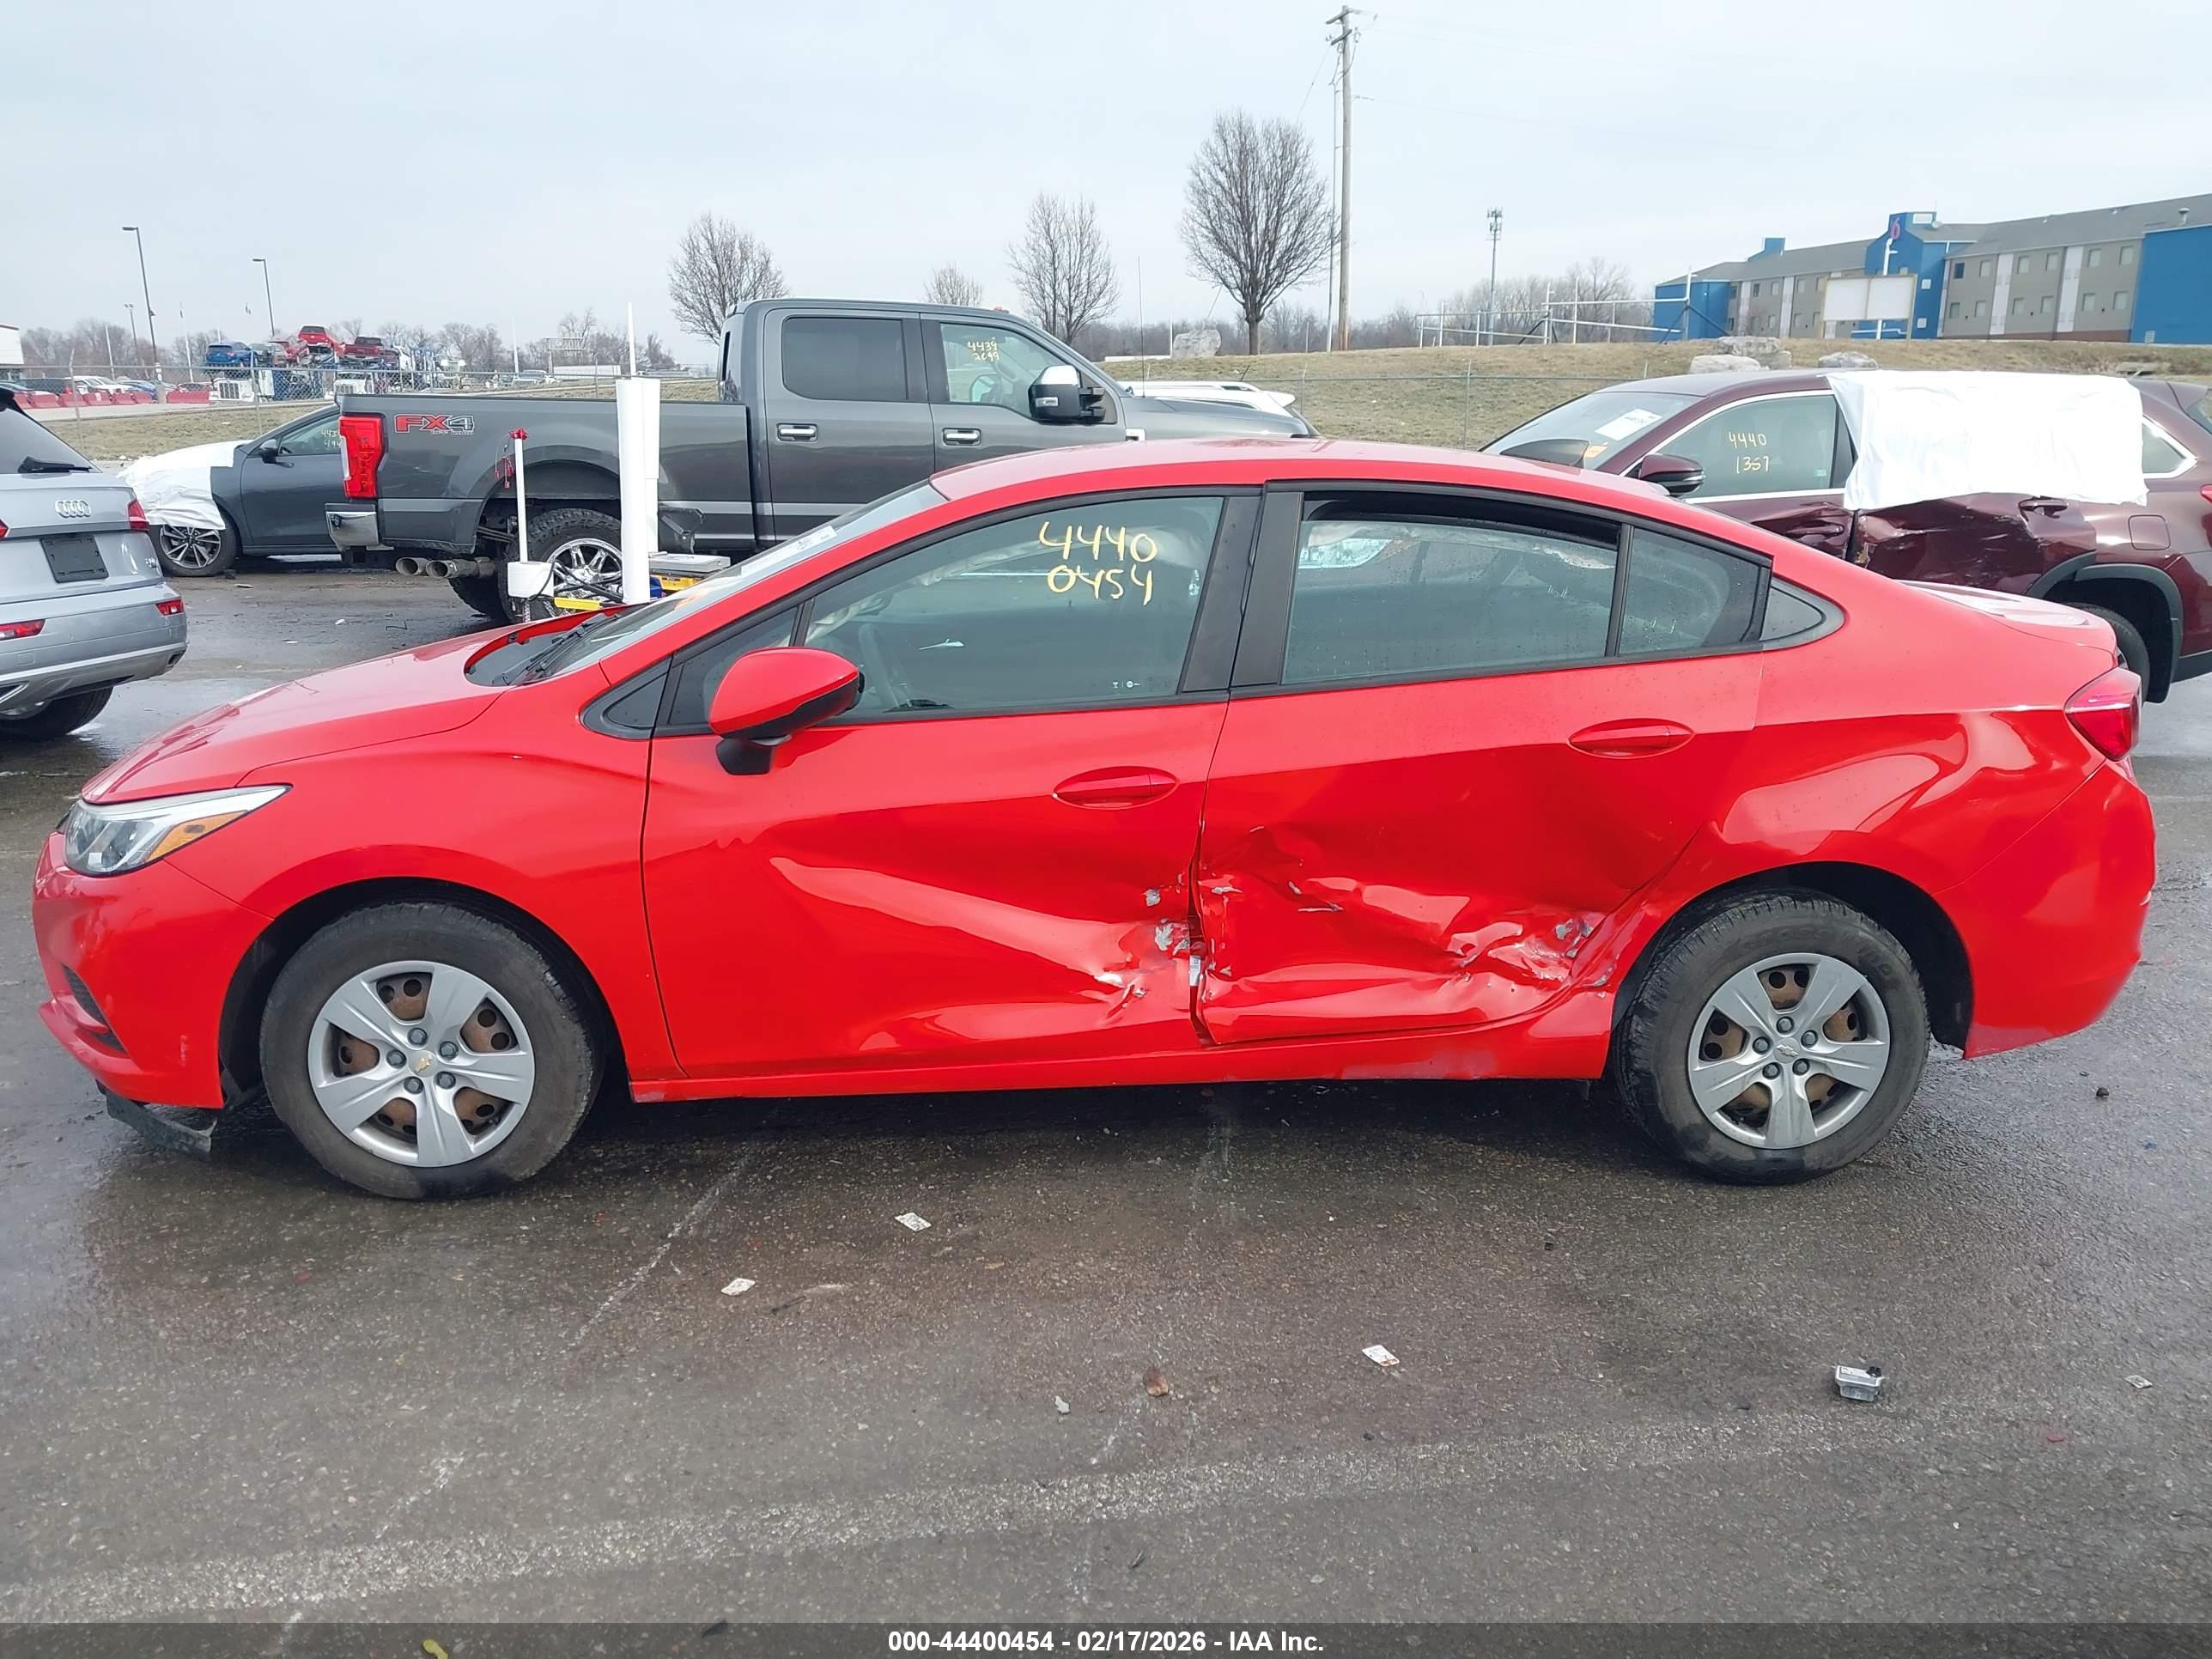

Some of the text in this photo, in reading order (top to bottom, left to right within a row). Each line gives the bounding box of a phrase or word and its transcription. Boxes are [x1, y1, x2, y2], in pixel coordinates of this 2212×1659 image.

[1890, 216, 1901, 240] 6
[394, 414, 475, 433] FX4
[1728, 431, 1767, 447] 4440
[1736, 455, 1770, 474] 1357
[1039, 521, 1158, 562] 4440
[1047, 563, 1153, 605] 0454
